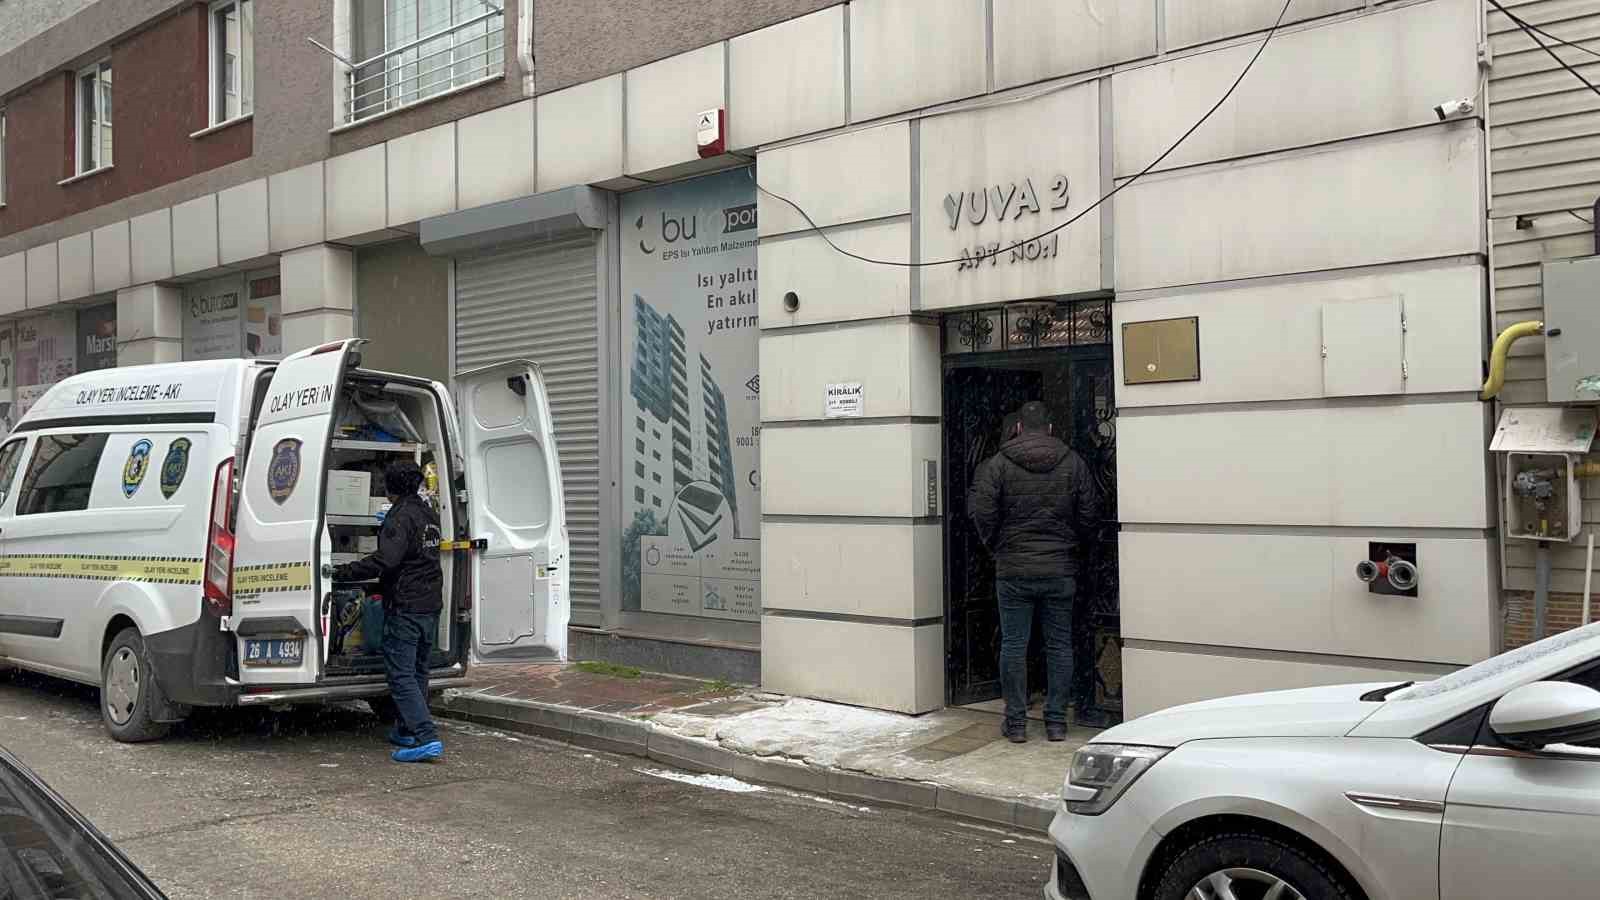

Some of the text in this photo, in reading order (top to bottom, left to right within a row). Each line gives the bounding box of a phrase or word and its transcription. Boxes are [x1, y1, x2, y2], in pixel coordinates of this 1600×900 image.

[944, 175, 1069, 231] YUVA 2
[663, 247, 679, 260] EPS
[958, 243, 1000, 271] APT
[707, 294, 723, 309] En
[76, 388, 98, 404] OLAY
[271, 391, 295, 412] OLAY
[250, 641, 300, 658] 26 A 4934
